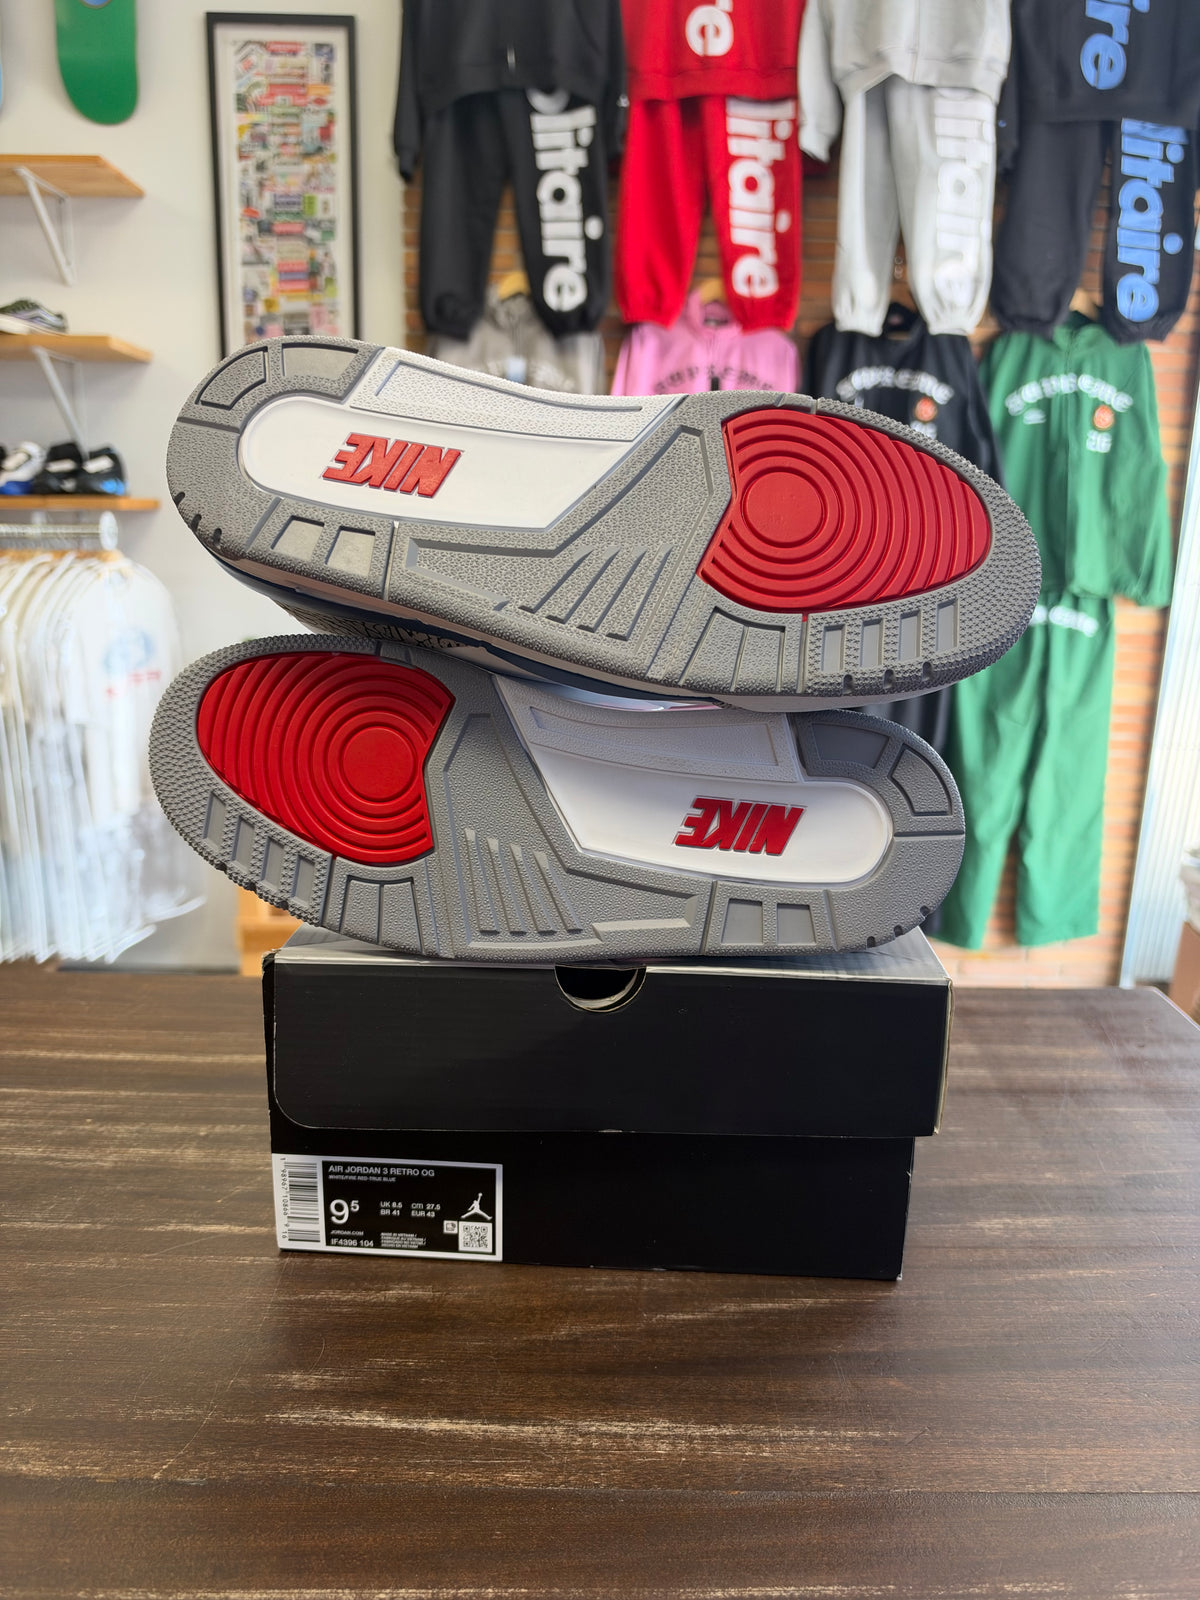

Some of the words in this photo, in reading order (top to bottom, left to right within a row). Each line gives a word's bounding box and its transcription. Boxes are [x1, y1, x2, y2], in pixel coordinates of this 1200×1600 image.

[684, 0, 734, 57] e
[322, 433, 462, 498] NIKE
[674, 796, 806, 856] NIKE
[328, 1165, 343, 1173] AIR
[345, 1166, 380, 1174] JORDAN
[383, 1167, 388, 1175] 3
[390, 1168, 419, 1176] RETRO
[421, 1169, 435, 1177] OG
[360, 1239, 374, 1247] 104
